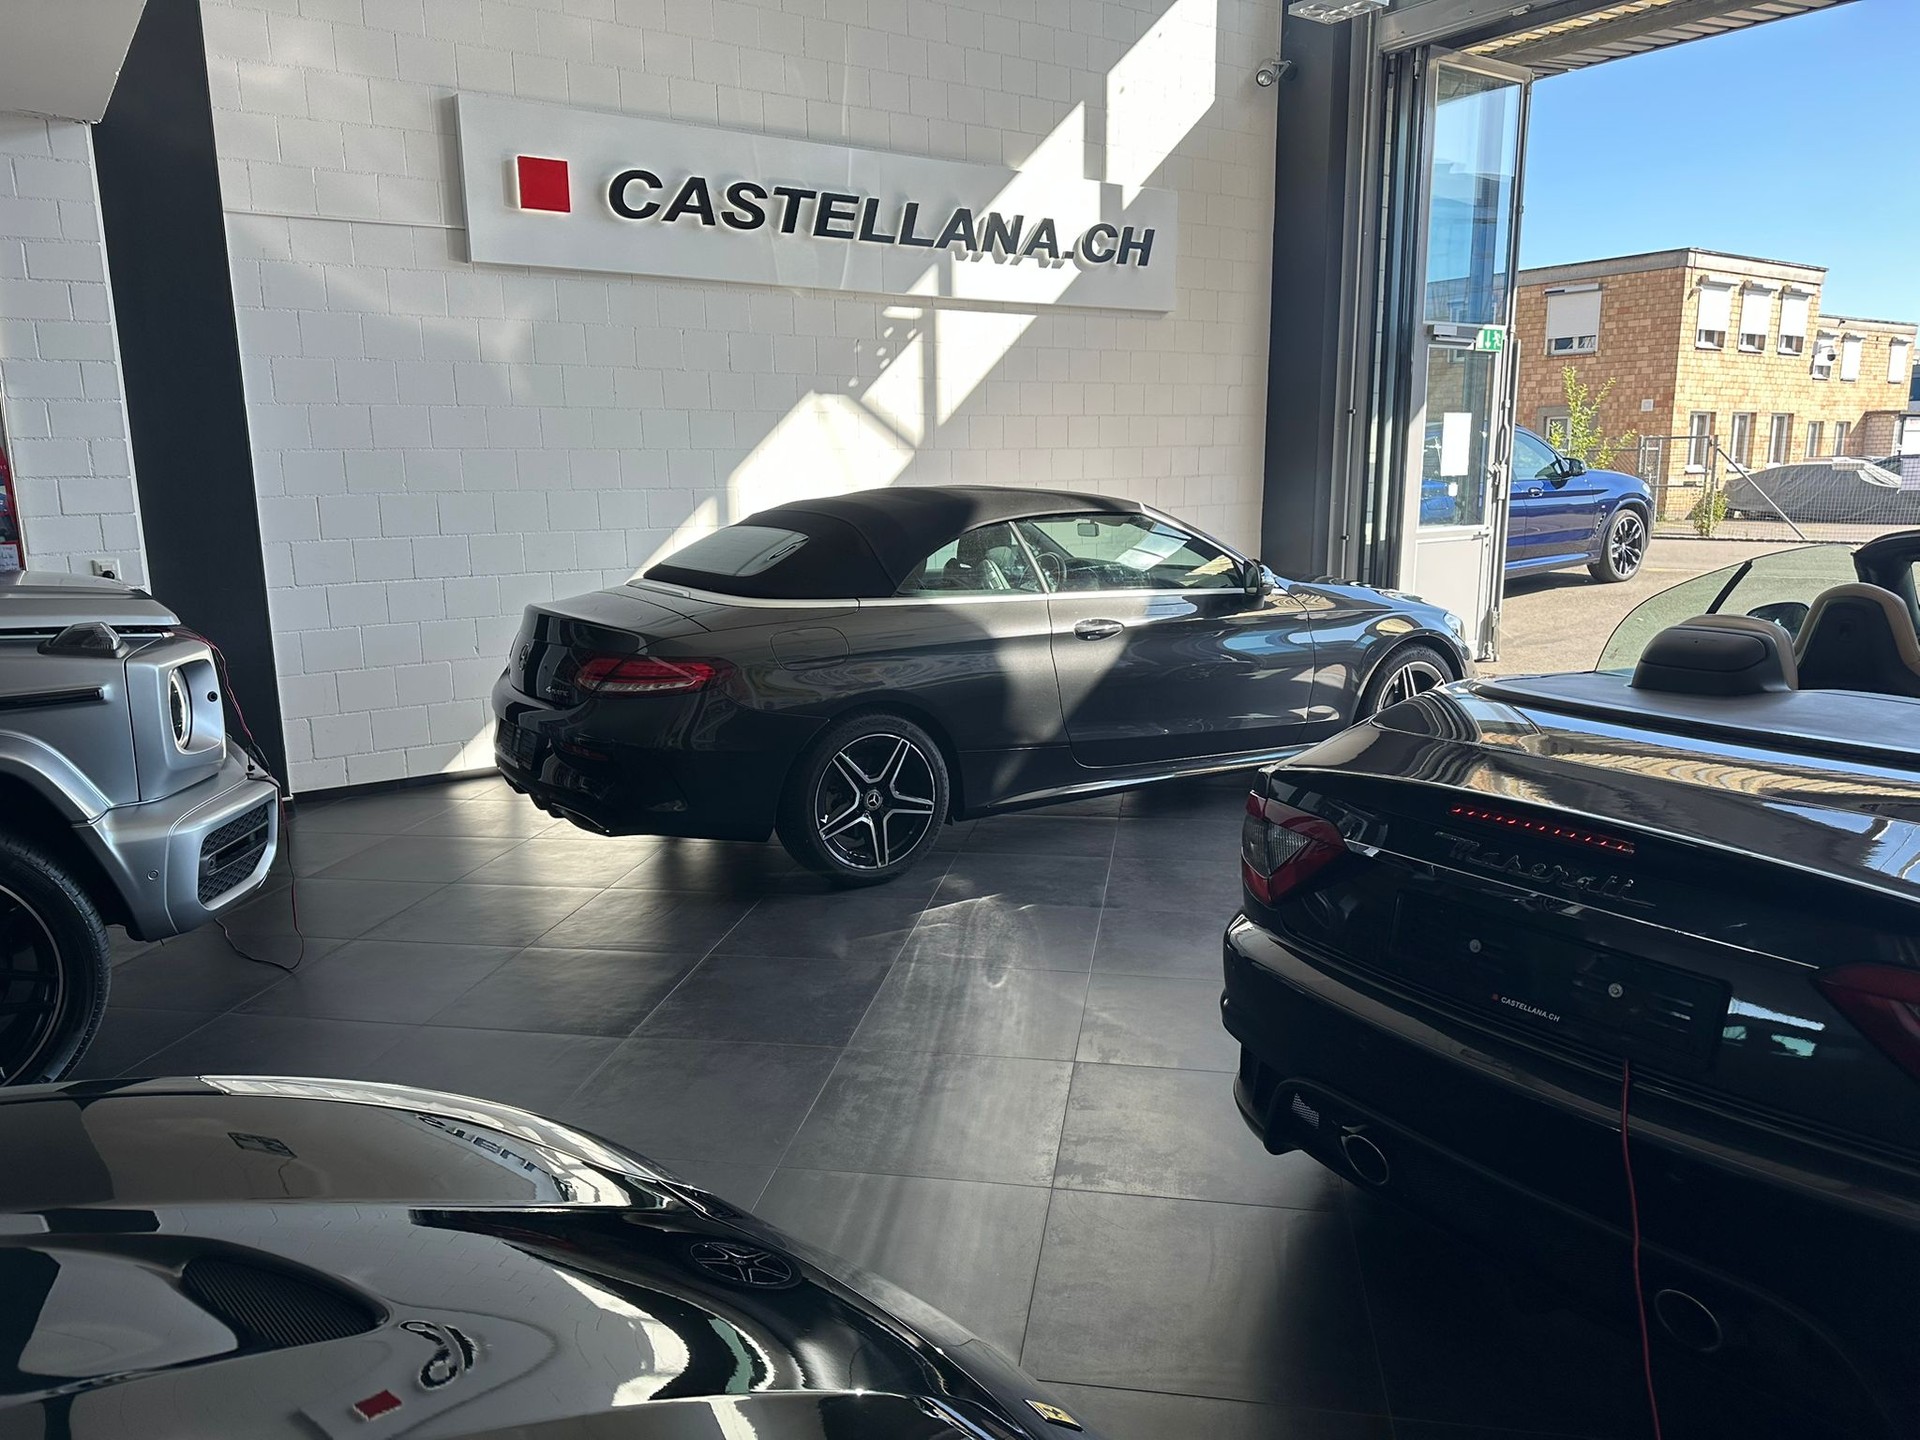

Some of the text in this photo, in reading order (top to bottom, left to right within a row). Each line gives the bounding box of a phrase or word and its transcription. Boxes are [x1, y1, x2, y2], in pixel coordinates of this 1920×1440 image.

[607, 168, 1156, 267] CASTELLANA.CH
[1434, 831, 1656, 907] Maserati
[1500, 996, 1561, 1022] CASTELLANA.CH
